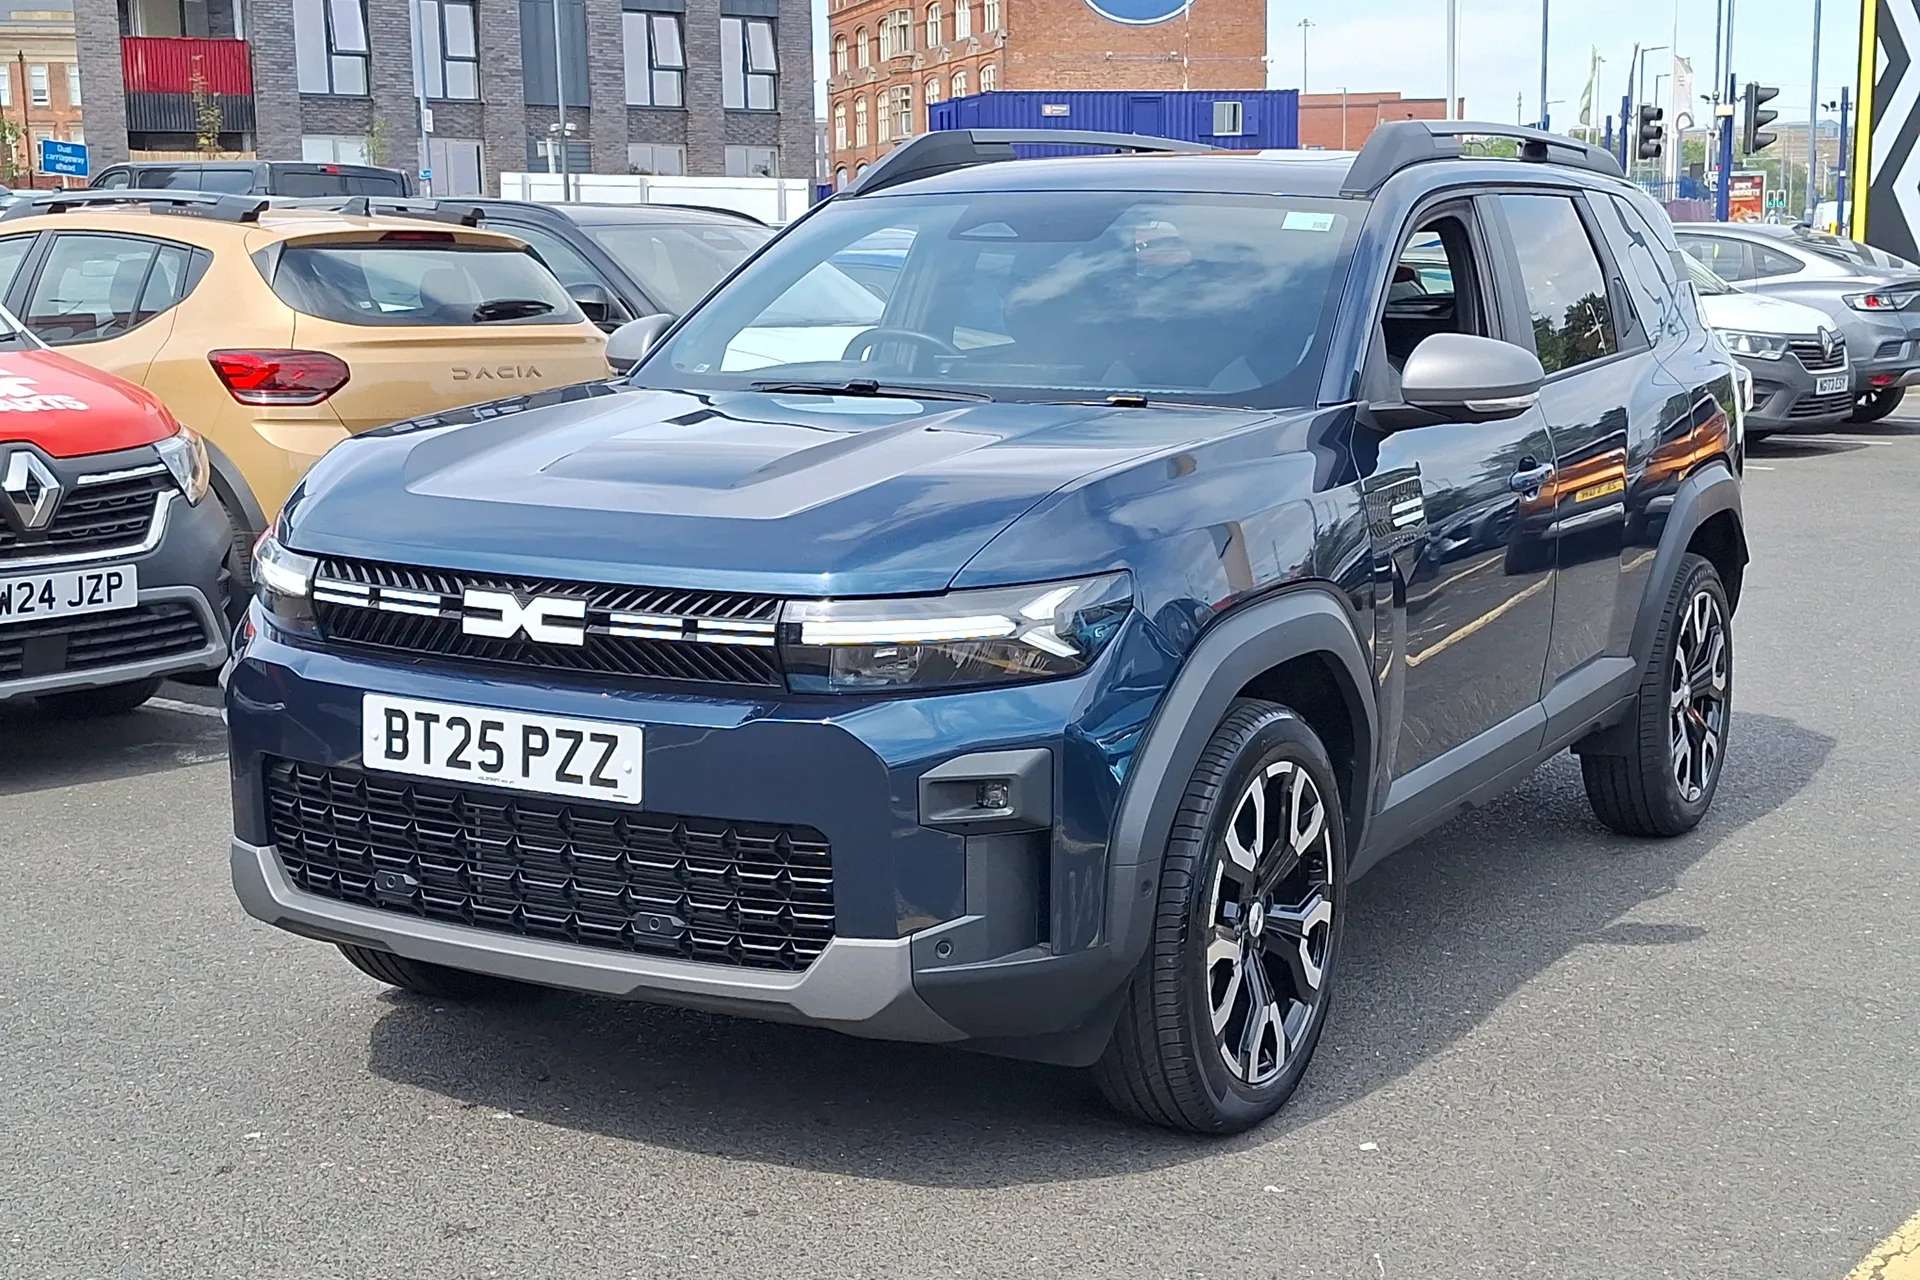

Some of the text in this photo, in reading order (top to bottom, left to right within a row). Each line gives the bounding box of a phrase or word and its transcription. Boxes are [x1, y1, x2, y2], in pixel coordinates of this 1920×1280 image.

[57, 144, 73, 154] Dual
[45, 153, 85, 165] carriageway
[55, 163, 76, 172] ahead
[451, 365, 542, 381] DACIA
[67, 571, 123, 608] JZP
[384, 707, 618, 790] BT25 PZZ
